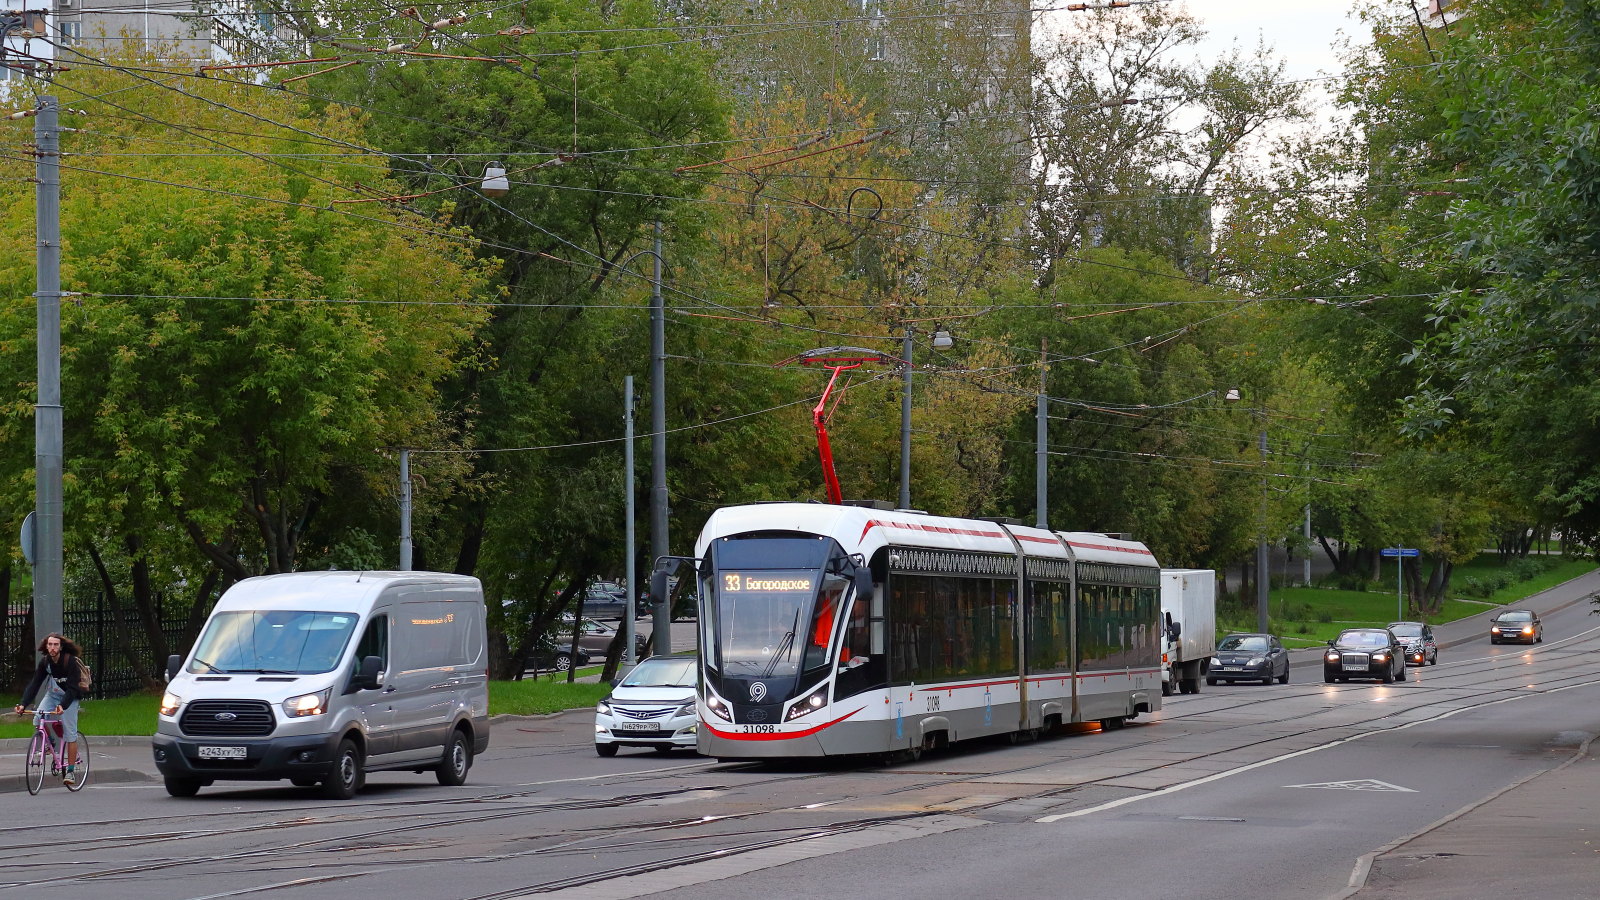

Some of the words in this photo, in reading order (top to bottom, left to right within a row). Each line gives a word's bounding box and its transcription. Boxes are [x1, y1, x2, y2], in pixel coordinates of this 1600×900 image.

[725, 575, 741, 591] 33
[746, 577, 810, 592] Богородское
[743, 724, 775, 734] 31098
